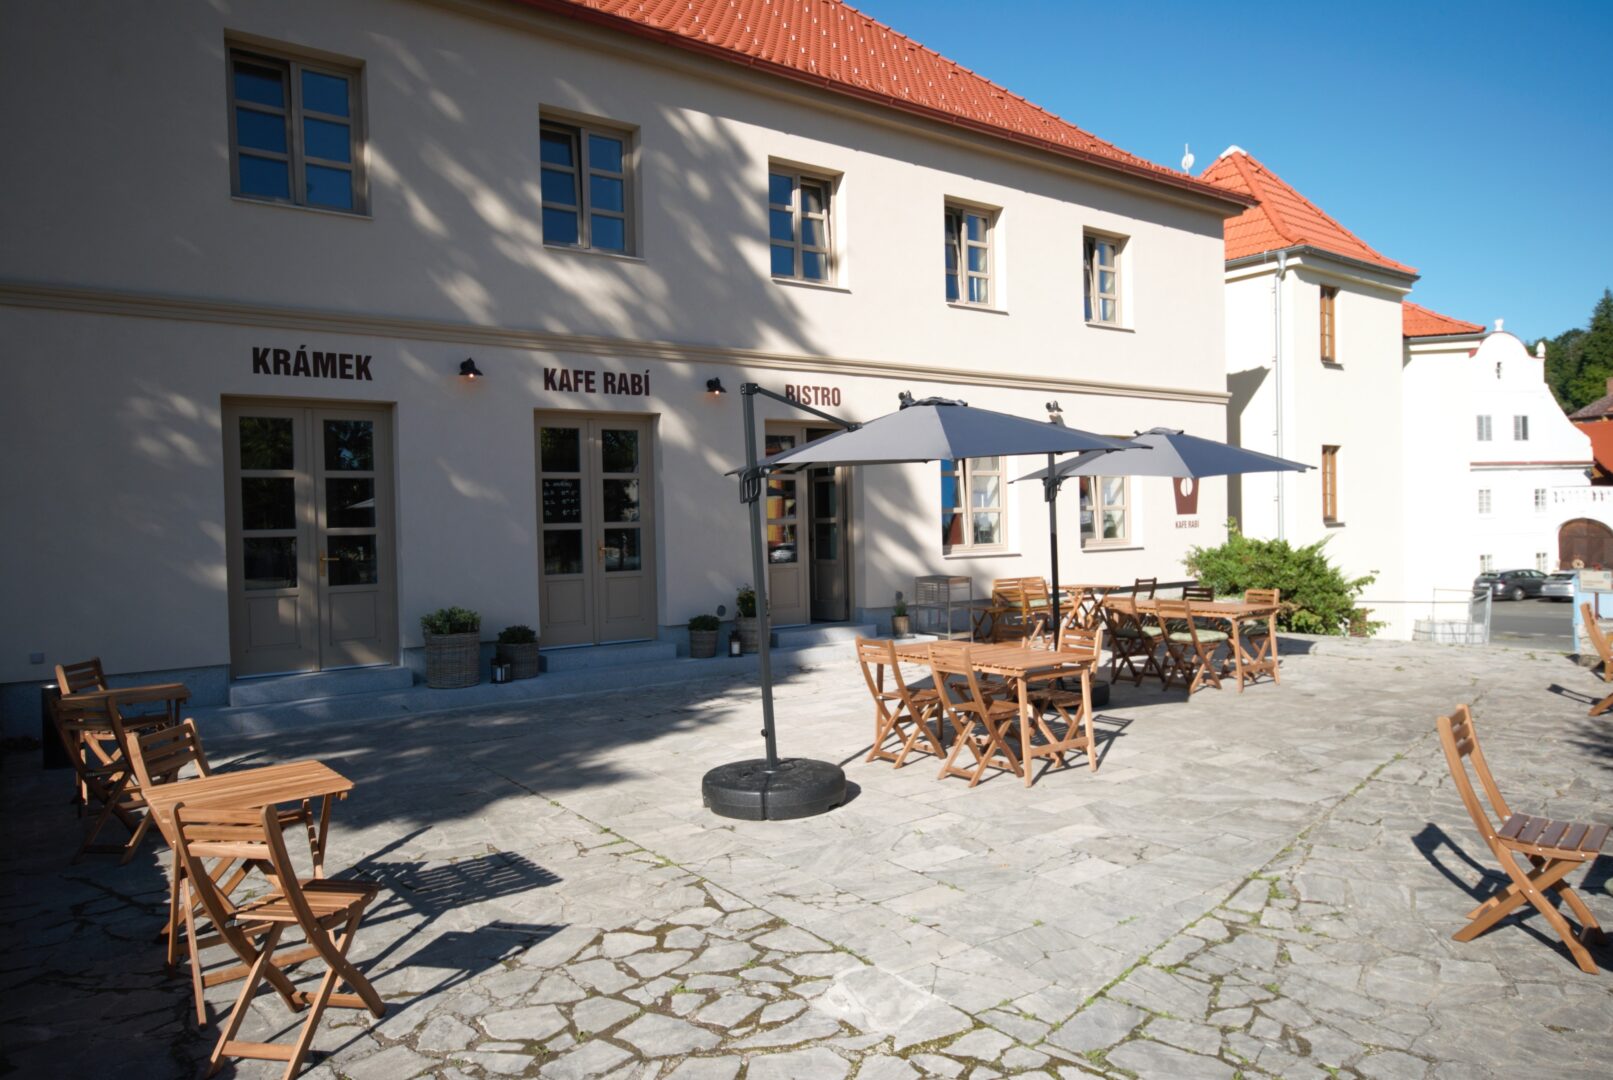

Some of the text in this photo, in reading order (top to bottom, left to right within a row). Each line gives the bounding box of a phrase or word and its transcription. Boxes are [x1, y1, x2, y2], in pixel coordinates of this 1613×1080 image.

[252, 345, 373, 381] KRÁMEK
[543, 367, 651, 396] KAFE RABÍ
[785, 384, 841, 406] BISTRO
[1175, 520, 1188, 529] KAFE
